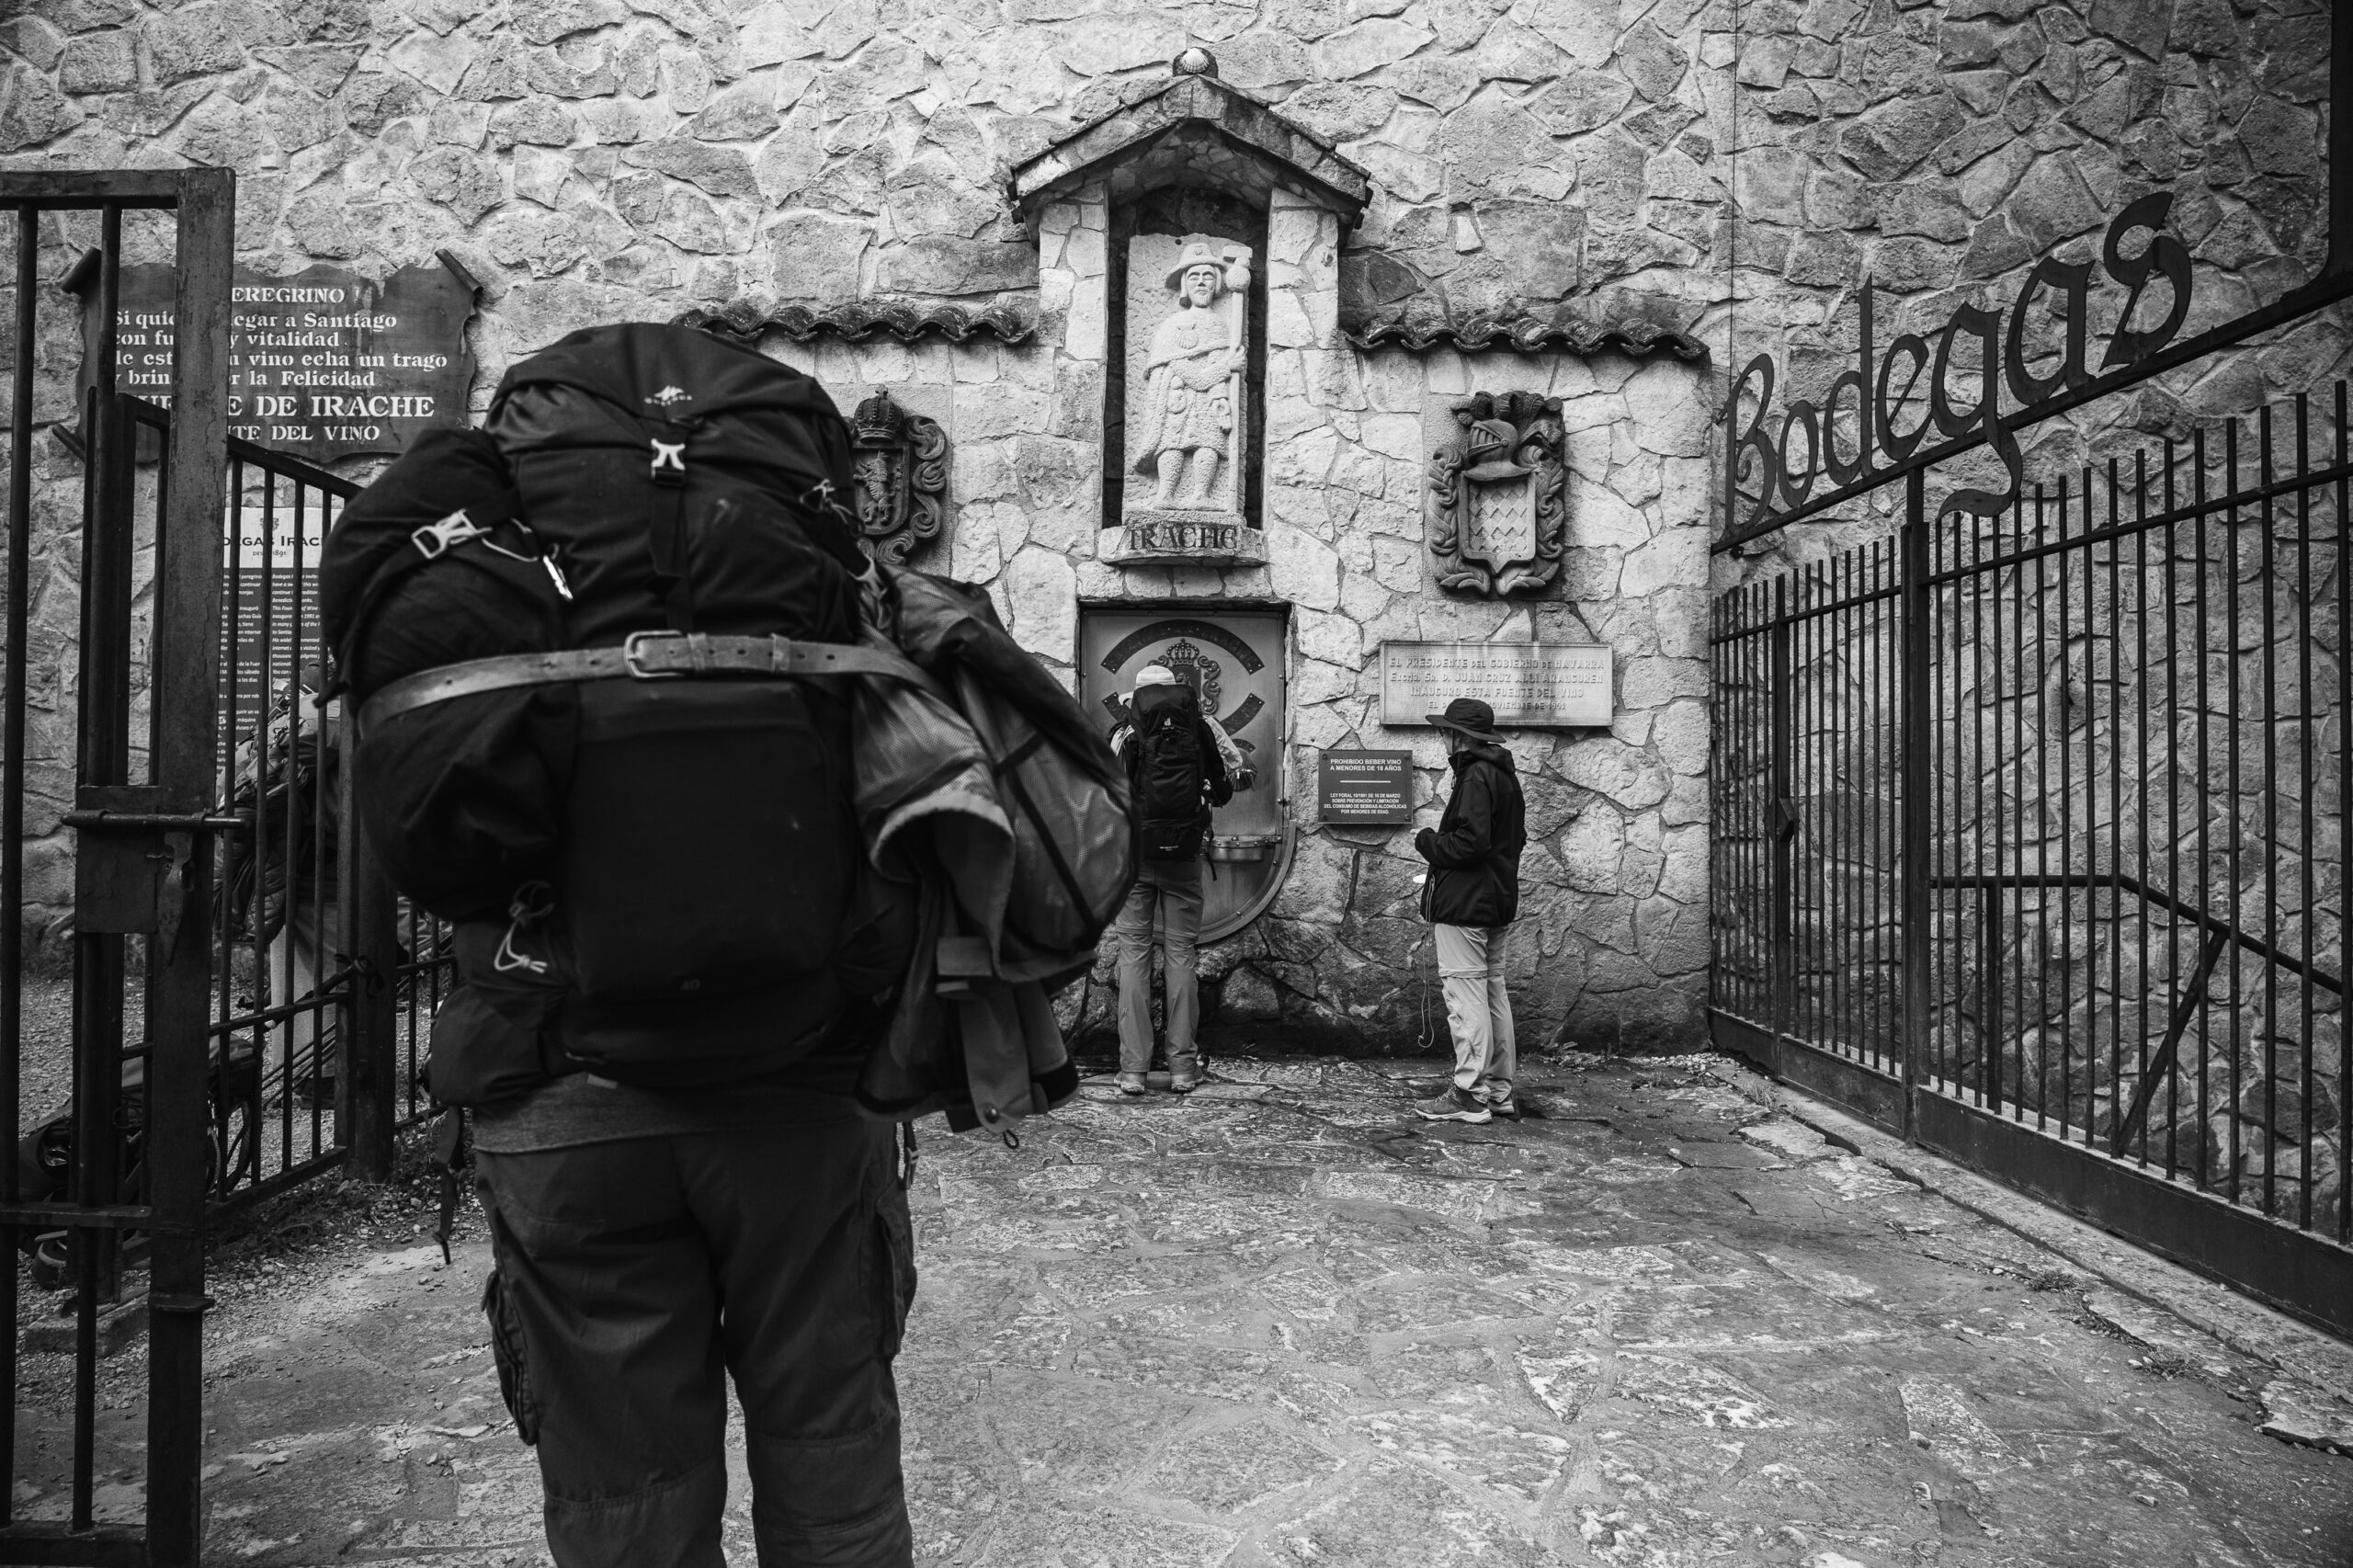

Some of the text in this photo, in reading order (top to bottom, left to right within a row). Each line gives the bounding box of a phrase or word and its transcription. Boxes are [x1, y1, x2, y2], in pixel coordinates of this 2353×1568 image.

[232, 288, 346, 303] EREGRINO
[135, 311, 175, 329] quie
[285, 314, 296, 327] a
[304, 312, 397, 333] Santiago
[247, 332, 340, 347] vitalidad
[143, 351, 173, 366] est
[248, 352, 294, 366] vino
[301, 351, 349, 366] echa
[358, 355, 384, 367] un
[393, 353, 449, 371] trago
[1717, 190, 2192, 538] Bodegas
[129, 369, 171, 384] brin
[249, 371, 267, 386] la
[281, 370, 375, 386] Felicidad
[256, 395, 298, 417] DE
[311, 395, 435, 417] IRACHE
[272, 426, 313, 440] DEL
[324, 426, 381, 441] VINO
[1130, 524, 1237, 550] IRACHE
[1390, 658, 1605, 669] EL PRESIDENTE DEL GOBIERNO DE NAVARRA
[1454, 673, 1483, 683] JUAN
[1485, 673, 1511, 684] CRUZ
[1463, 687, 1491, 697] ESTA
[1495, 687, 1533, 698] FUENTE
[1537, 687, 1556, 699] DEL
[1559, 688, 1583, 699] VINO
[1549, 702, 1566, 710] 1991
